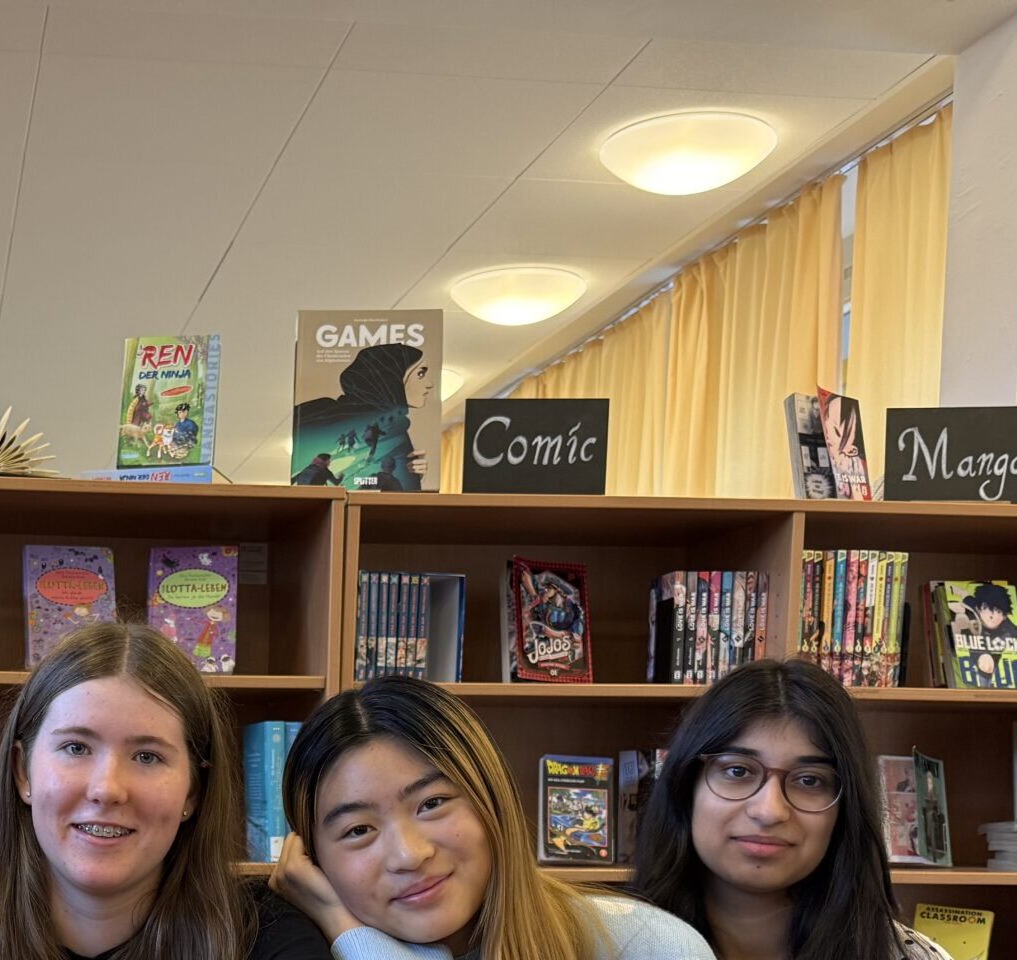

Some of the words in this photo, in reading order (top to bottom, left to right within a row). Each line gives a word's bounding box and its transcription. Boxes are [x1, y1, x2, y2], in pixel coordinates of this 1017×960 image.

[314, 324, 424, 348] GAMES
[141, 344, 194, 369] REN
[139, 372, 158, 380] DER
[161, 370, 191, 380] NINJA
[472, 416, 597, 468] Comic
[166, 582, 227, 594] LOTTA-LEBEN
[676, 616, 684, 630] LOVE
[956, 634, 984, 649] BLUE
[926, 906, 982, 916] ASSASSINATION
[920, 912, 986, 925] CLASSROOM
